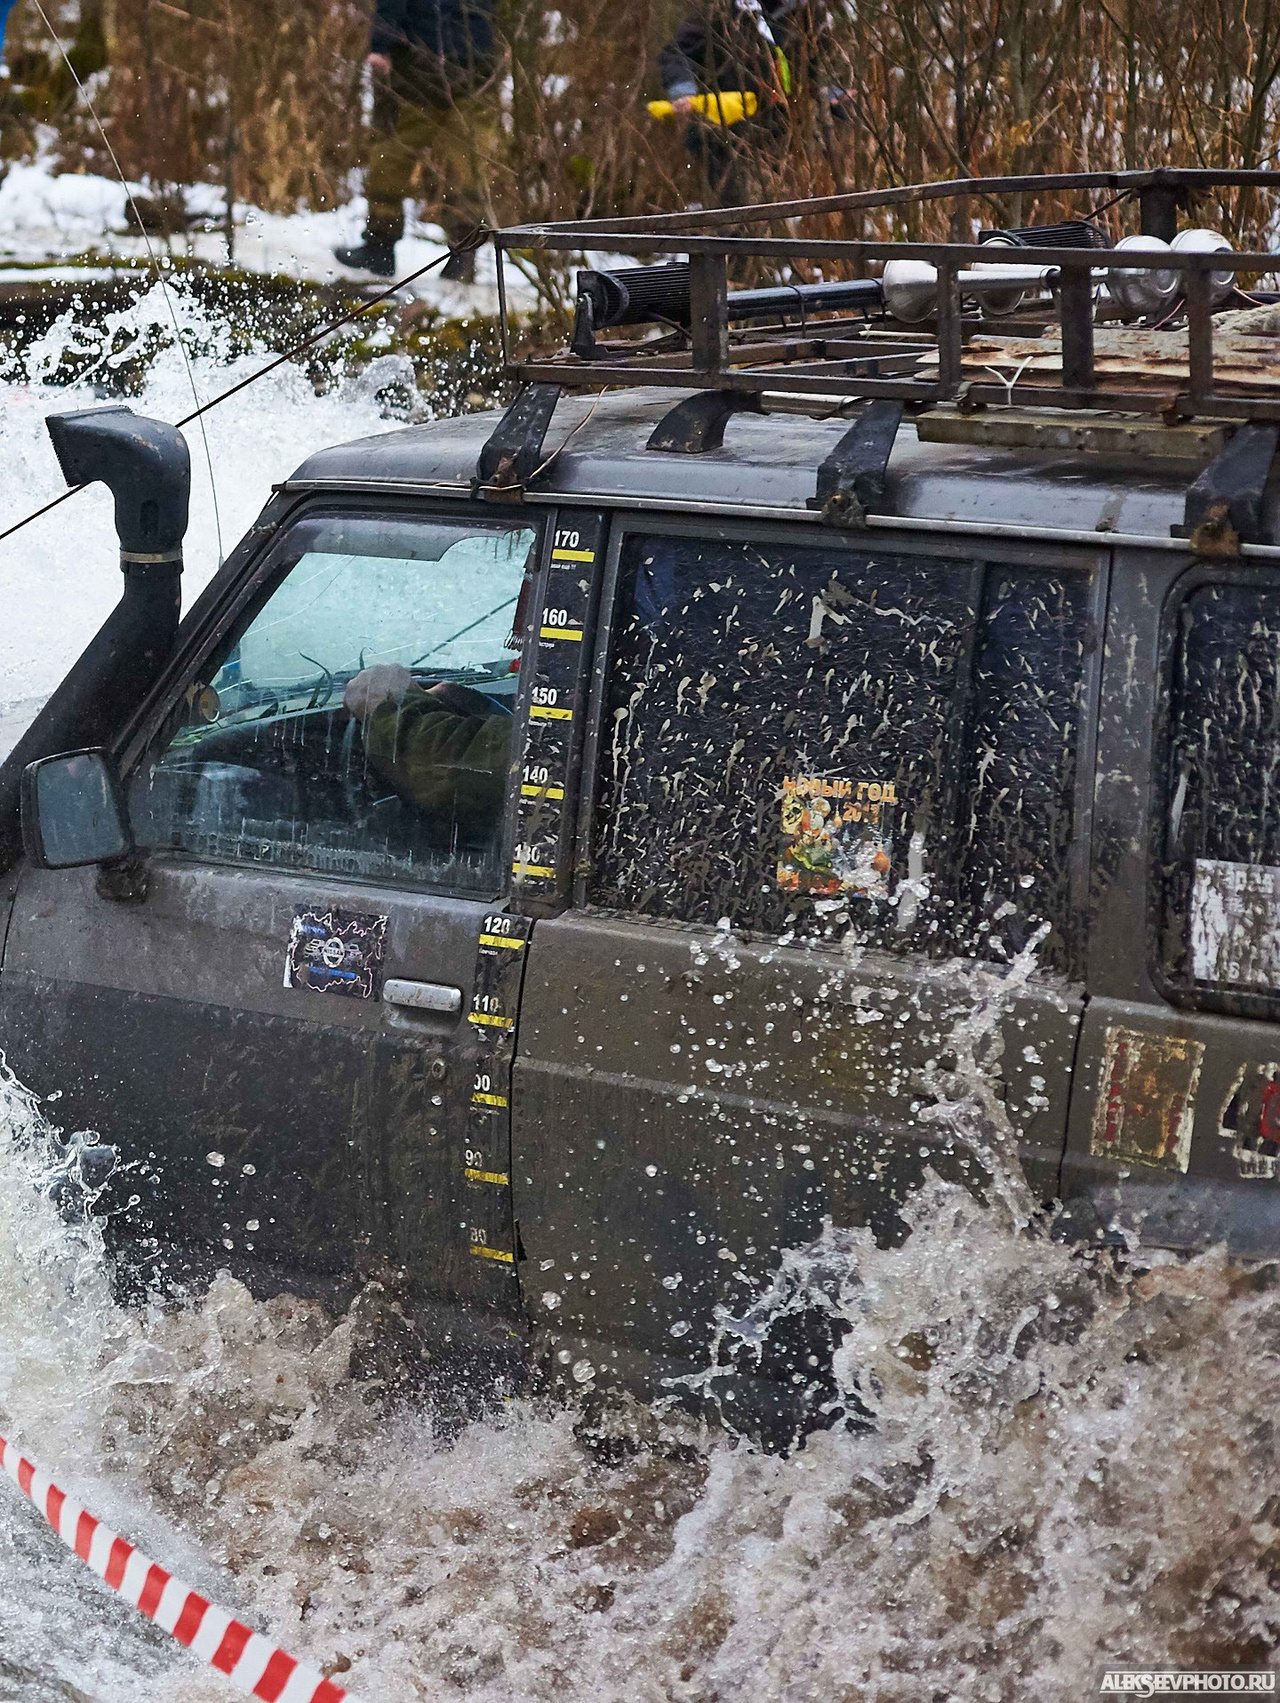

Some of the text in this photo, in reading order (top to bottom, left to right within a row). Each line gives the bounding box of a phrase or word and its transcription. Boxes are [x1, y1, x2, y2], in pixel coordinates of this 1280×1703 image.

[554, 530, 580, 548] 170
[542, 607, 568, 627] 160
[531, 686, 558, 706] 150
[522, 765, 549, 784] 140
[484, 916, 511, 935] 120
[473, 993, 499, 1012] 110
